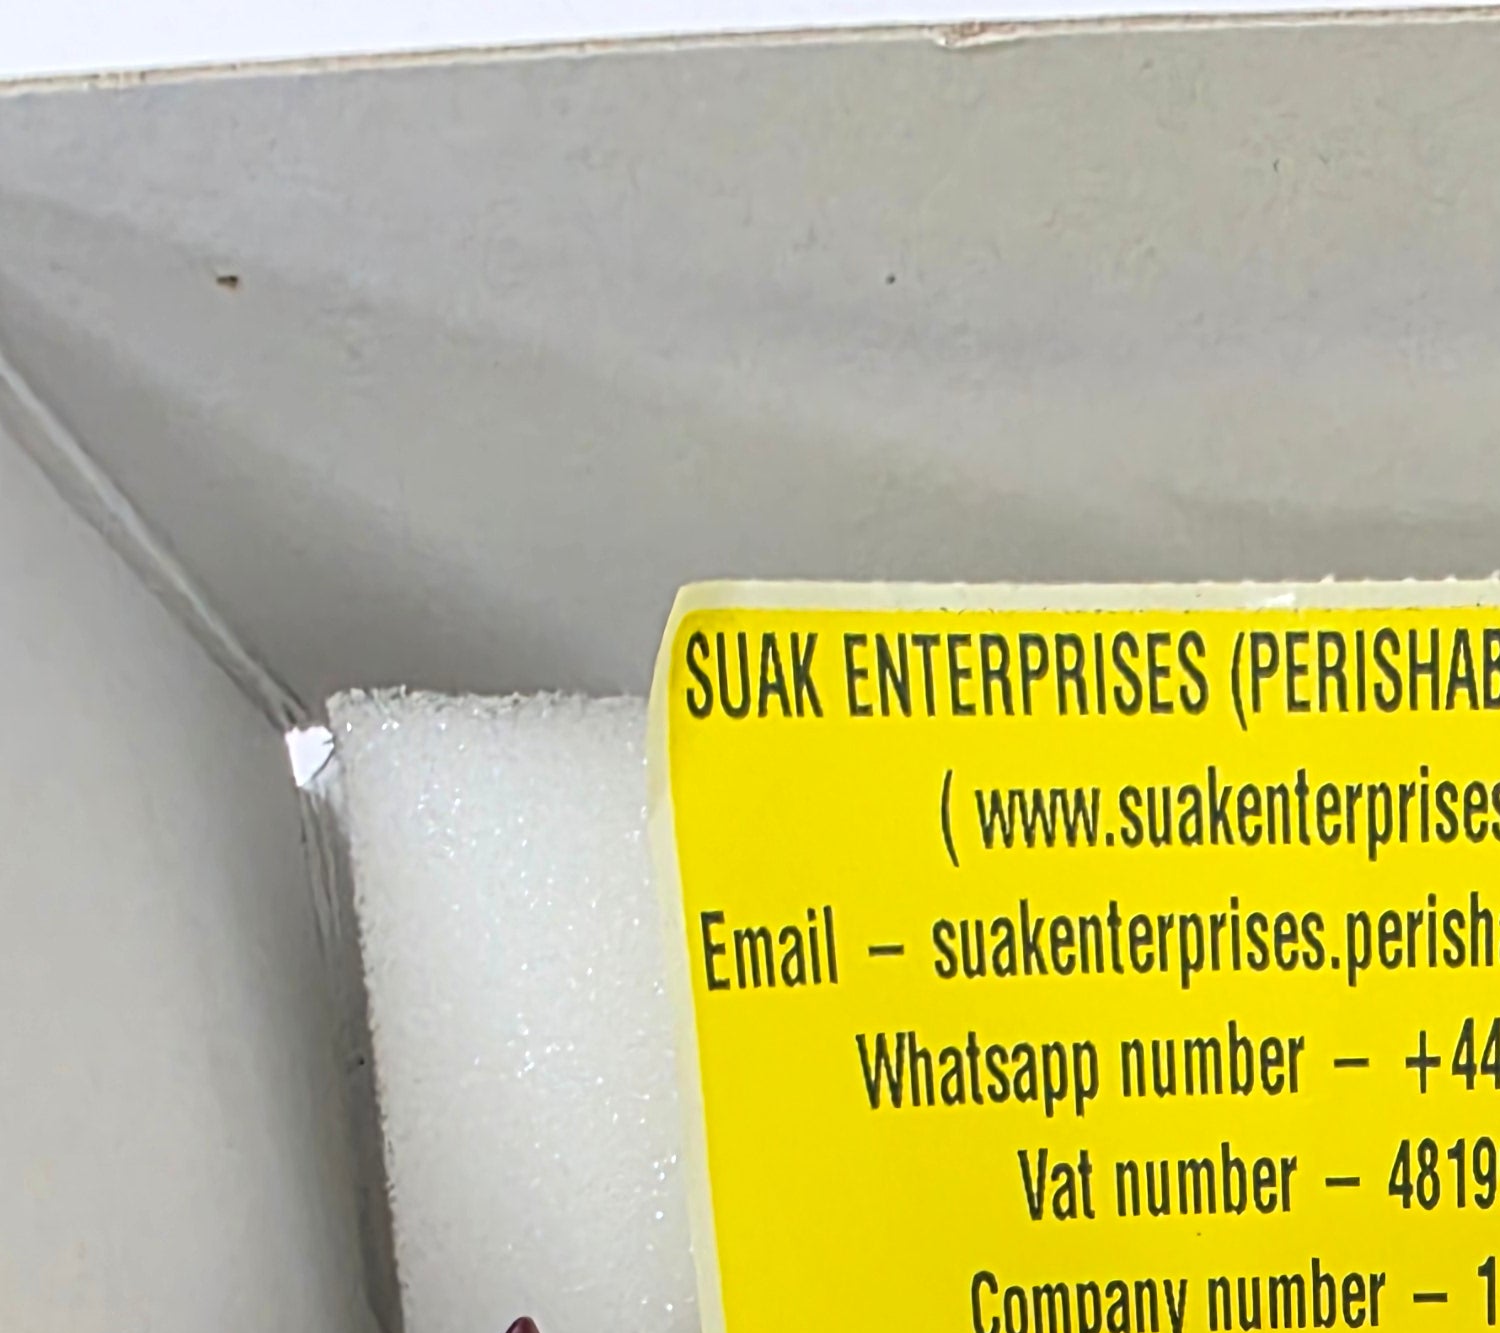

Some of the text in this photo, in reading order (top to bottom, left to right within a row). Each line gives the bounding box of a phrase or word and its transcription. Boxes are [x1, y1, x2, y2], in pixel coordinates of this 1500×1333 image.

[685, 629, 824, 720] SUAK
[842, 629, 1209, 718] ENTERPRISES
[699, 904, 839, 992] Email
[854, 1030, 1100, 1119] Whatsapp
[1120, 1019, 1306, 1099] number
[1016, 1147, 1097, 1222] Vat
[1114, 1140, 1298, 1218] number
[1206, 1256, 1387, 1333] number
